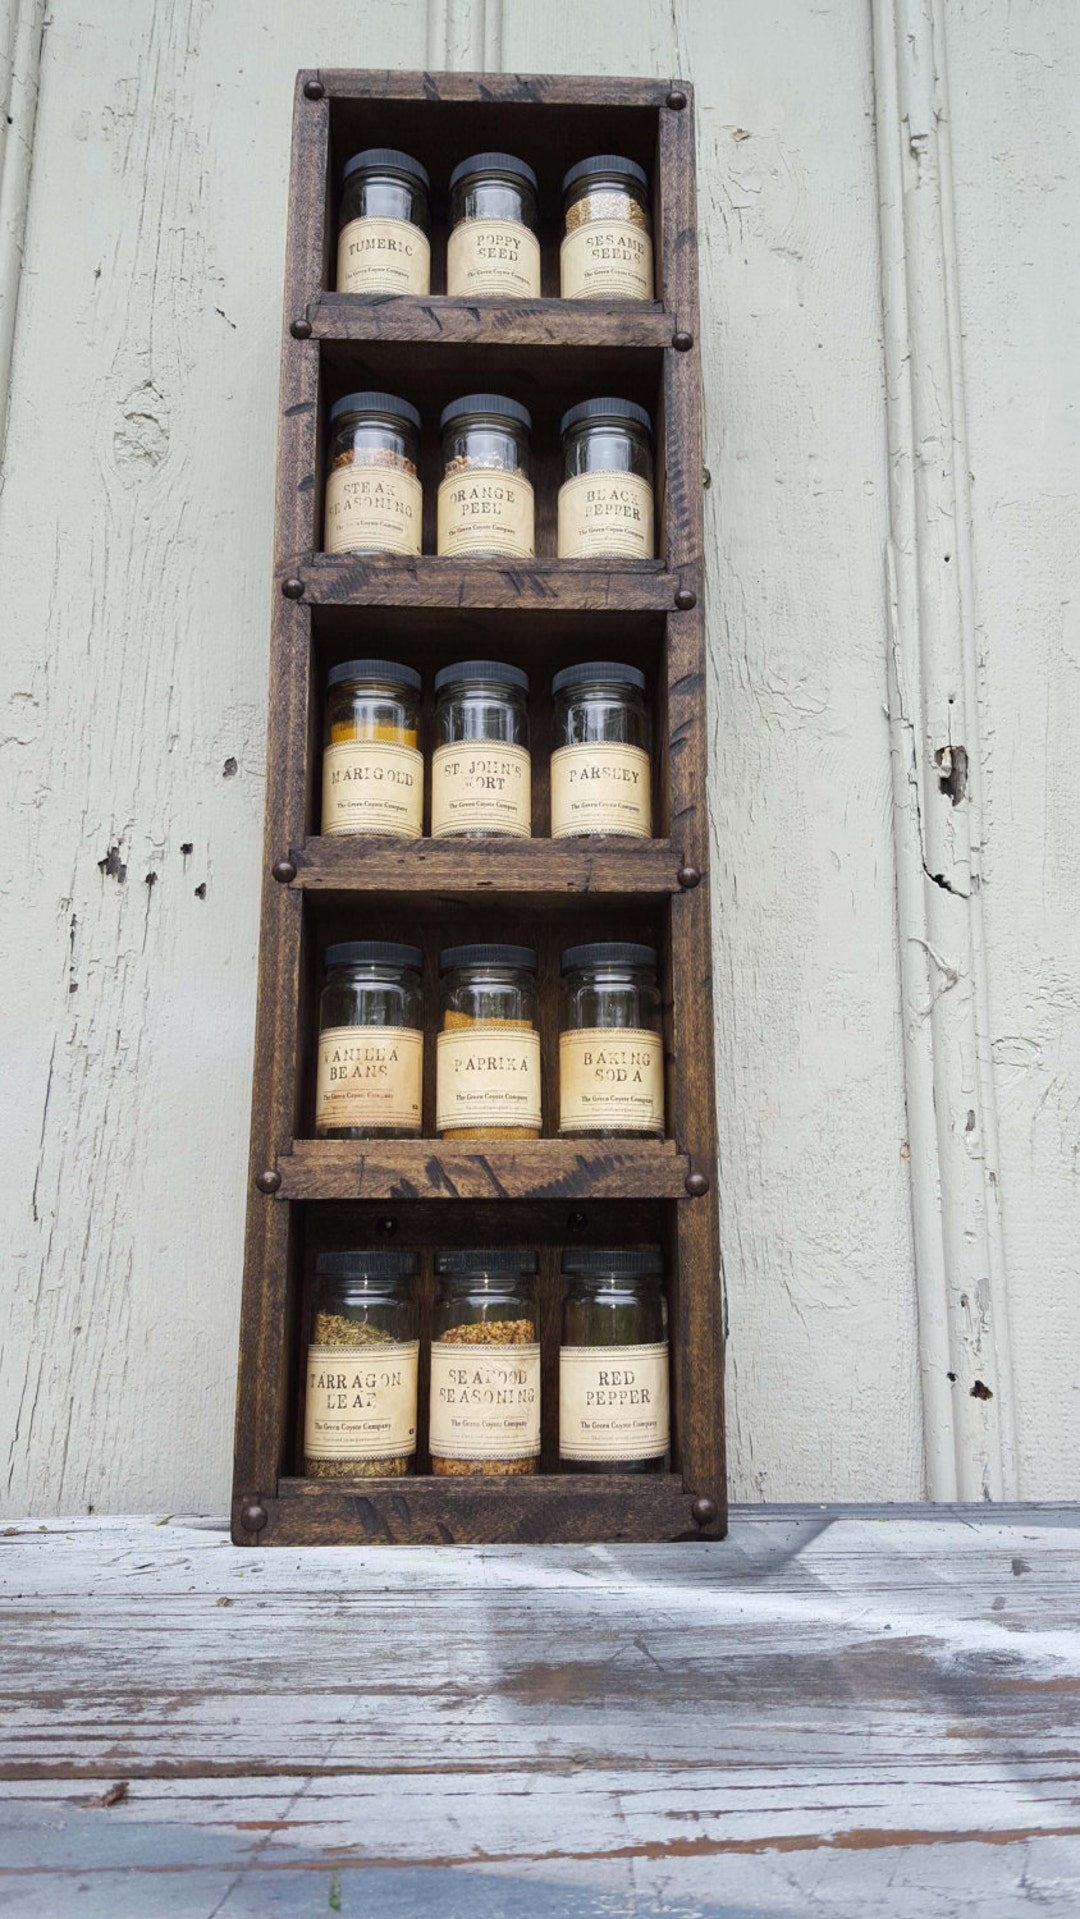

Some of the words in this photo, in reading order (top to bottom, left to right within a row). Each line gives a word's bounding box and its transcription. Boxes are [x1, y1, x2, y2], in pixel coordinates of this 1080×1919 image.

[348, 238, 413, 256] TUMERIC
[477, 234, 521, 249] POPPY
[586, 234, 645, 255] SESAME
[478, 247, 518, 261] SEED
[592, 247, 641, 264] SEEDS
[343, 481, 395, 496] STEAK
[450, 487, 515, 503] ORANGE
[586, 489, 639, 506] BLACK
[461, 502, 502, 516] PEEL
[585, 504, 641, 521] PEPPER
[331, 767, 413, 786] MARIGOLD
[469, 760, 522, 779] JOHN'S
[569, 766, 640, 784] PARSLEY
[454, 1057, 528, 1072] PAPRIKA
[583, 1052, 651, 1067] BAKING
[330, 1065, 388, 1081] BEANS
[594, 1069, 642, 1083] SODA
[505, 1093, 528, 1103] Company
[630, 1096, 653, 1105] Company
[310, 1372, 402, 1389] TARRAGON
[448, 1369, 527, 1385] SEAFOOD
[598, 1370, 635, 1386] RED
[327, 1392, 376, 1409] LEAF
[439, 1387, 535, 1404] SEASONING
[586, 1388, 651, 1406] PEPPER
[323, 1423, 340, 1431] Green
[362, 1422, 391, 1431] Company
[450, 1419, 461, 1427] The
[503, 1420, 527, 1428] Company
[580, 1421, 591, 1429] The
[591, 1421, 610, 1429] Green
[632, 1420, 657, 1428] Company
